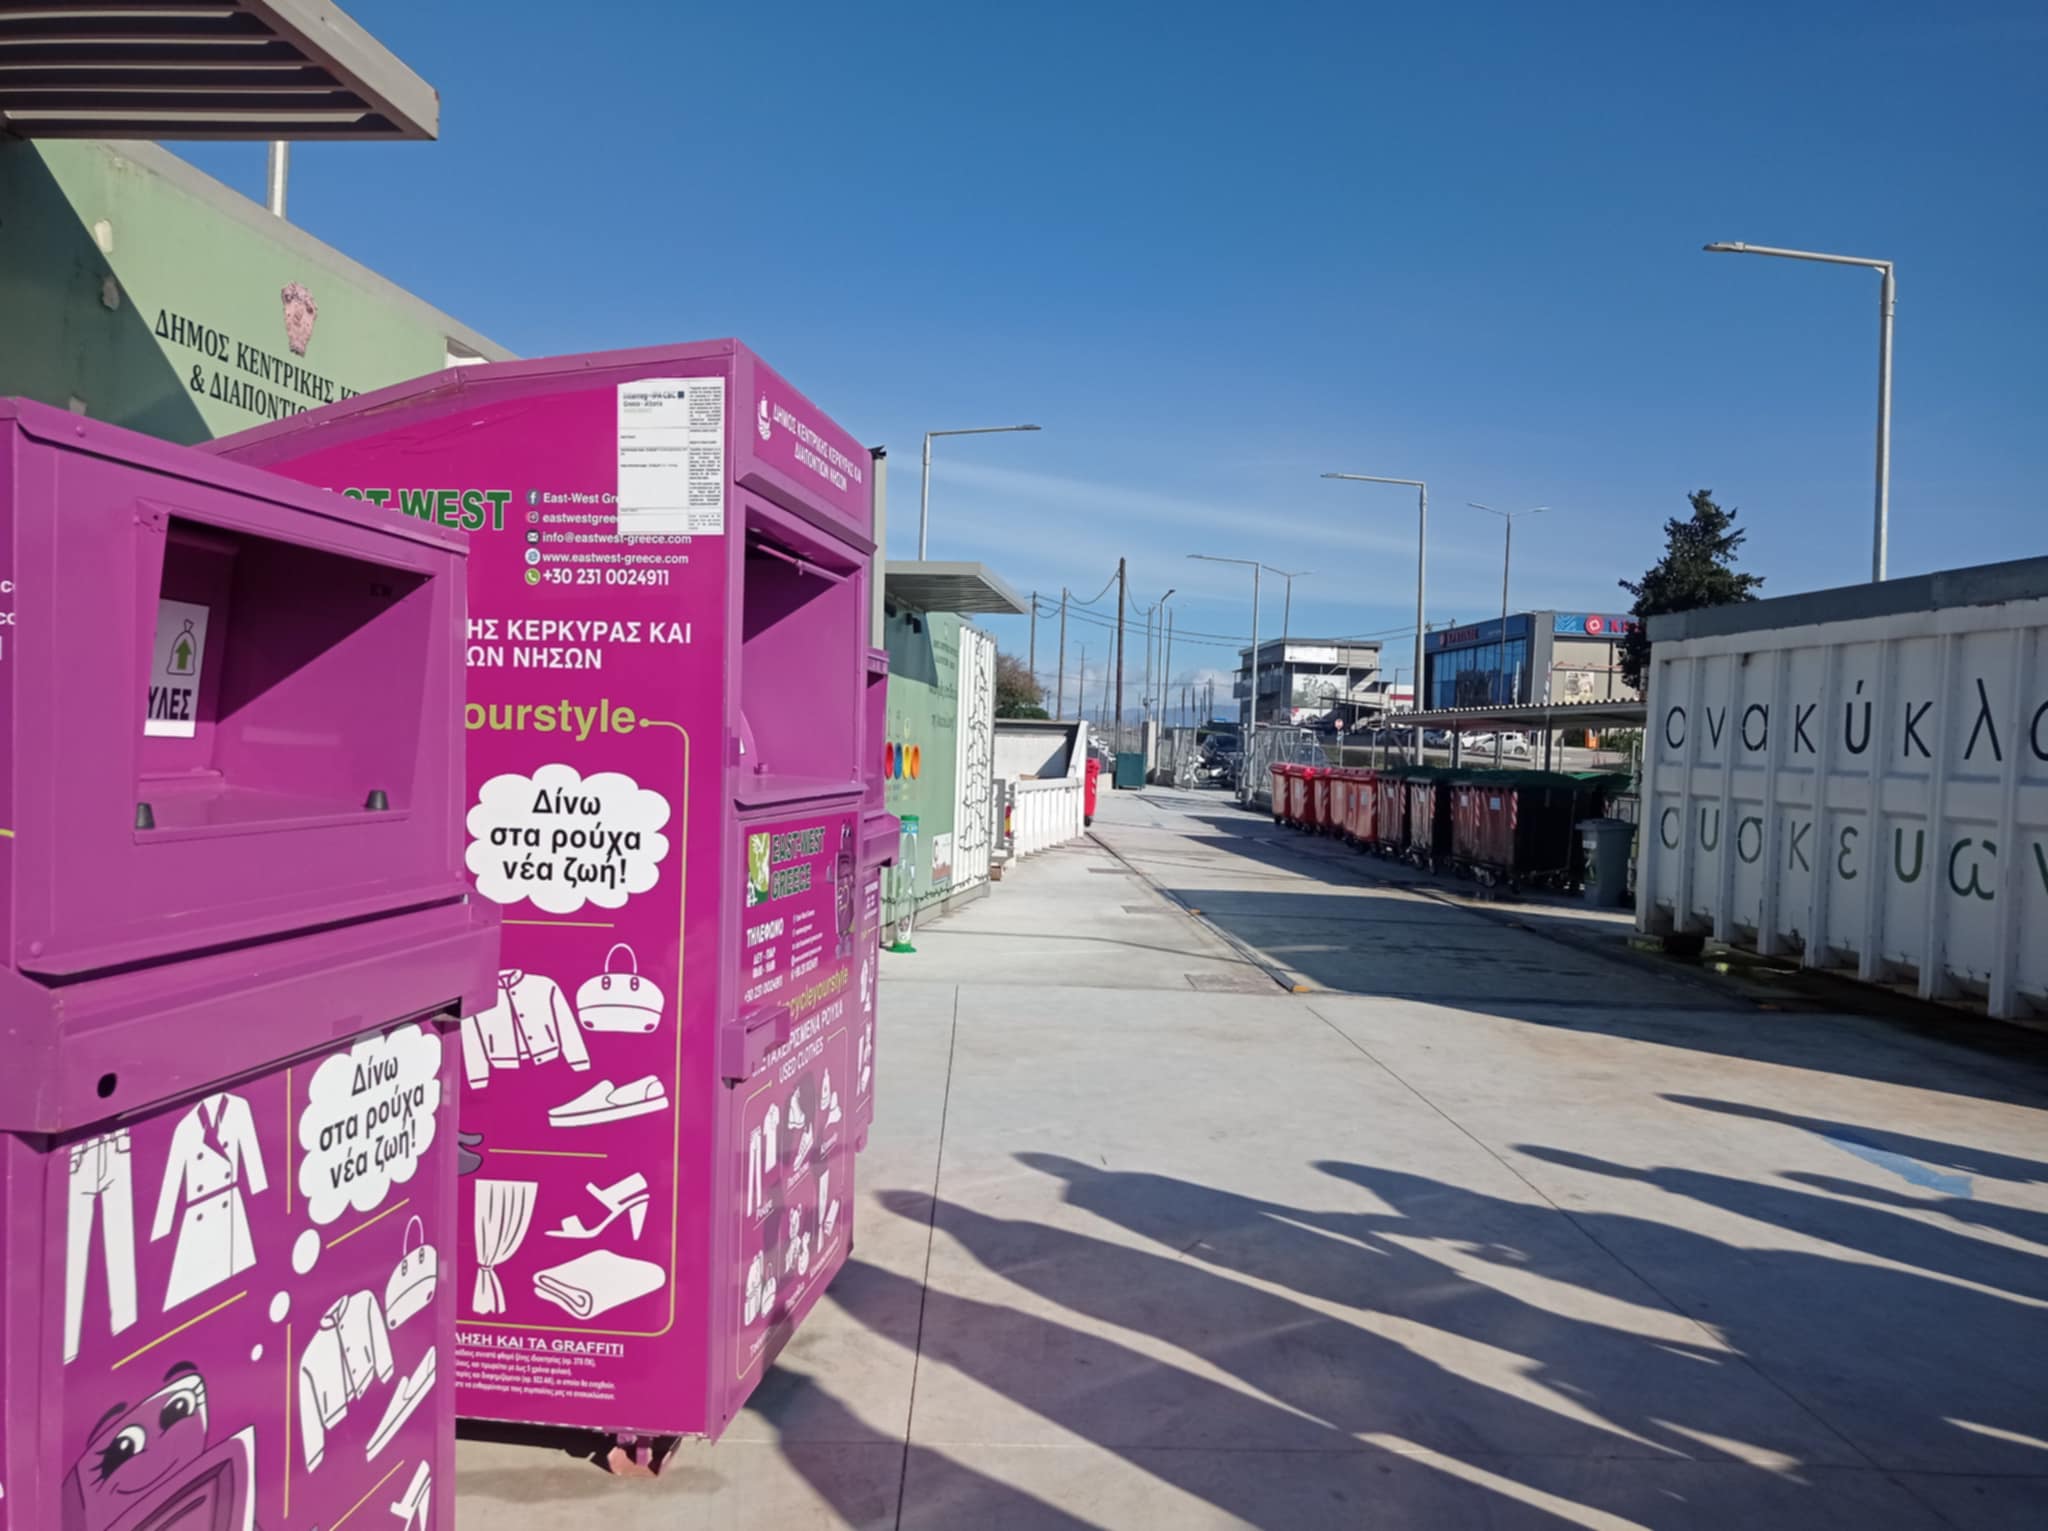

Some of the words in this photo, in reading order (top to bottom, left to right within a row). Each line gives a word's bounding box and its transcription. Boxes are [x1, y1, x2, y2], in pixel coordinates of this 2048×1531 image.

[155, 308, 230, 363] ΔΗΜΟΣ
[236, 341, 335, 404] ΚΕΝΤΡΙΚΗΣ
[190, 364, 205, 395] &
[209, 371, 308, 420] ΔΙΑΠΟΝΤΙ
[543, 492, 599, 504] East-West
[542, 534, 692, 546] info@eastwest-greece.com
[542, 552, 689, 566] www.eastwest-greece.com
[543, 567, 573, 585] +30
[576, 567, 602, 585] 231
[605, 568, 670, 586] 0024911
[507, 619, 643, 644] ΚΕΡΚΥΡΑΣ
[649, 622, 692, 644] ΚΑΙ
[466, 646, 504, 668] ΩΝ
[512, 647, 603, 669] ΝΗΣΩΝ
[464, 698, 636, 742] ourstyle
[532, 786, 602, 816] Δίνω
[489, 826, 541, 847] στα
[552, 821, 642, 857] ρούχα
[771, 825, 826, 864] EAST-WEST
[502, 852, 553, 881] νέα
[563, 854, 627, 890] ζωή!
[771, 862, 812, 902] GREECE
[351, 1055, 399, 1097] Δίνω
[319, 1112, 359, 1152] στα
[366, 1083, 425, 1139] ρούχα
[330, 1146, 368, 1190] νέα
[373, 1118, 416, 1174] ζωή!
[497, 1334, 524, 1349] ΚΑΙ
[528, 1337, 548, 1351] ΤΑ
[551, 1338, 625, 1357] GRAFFITI
